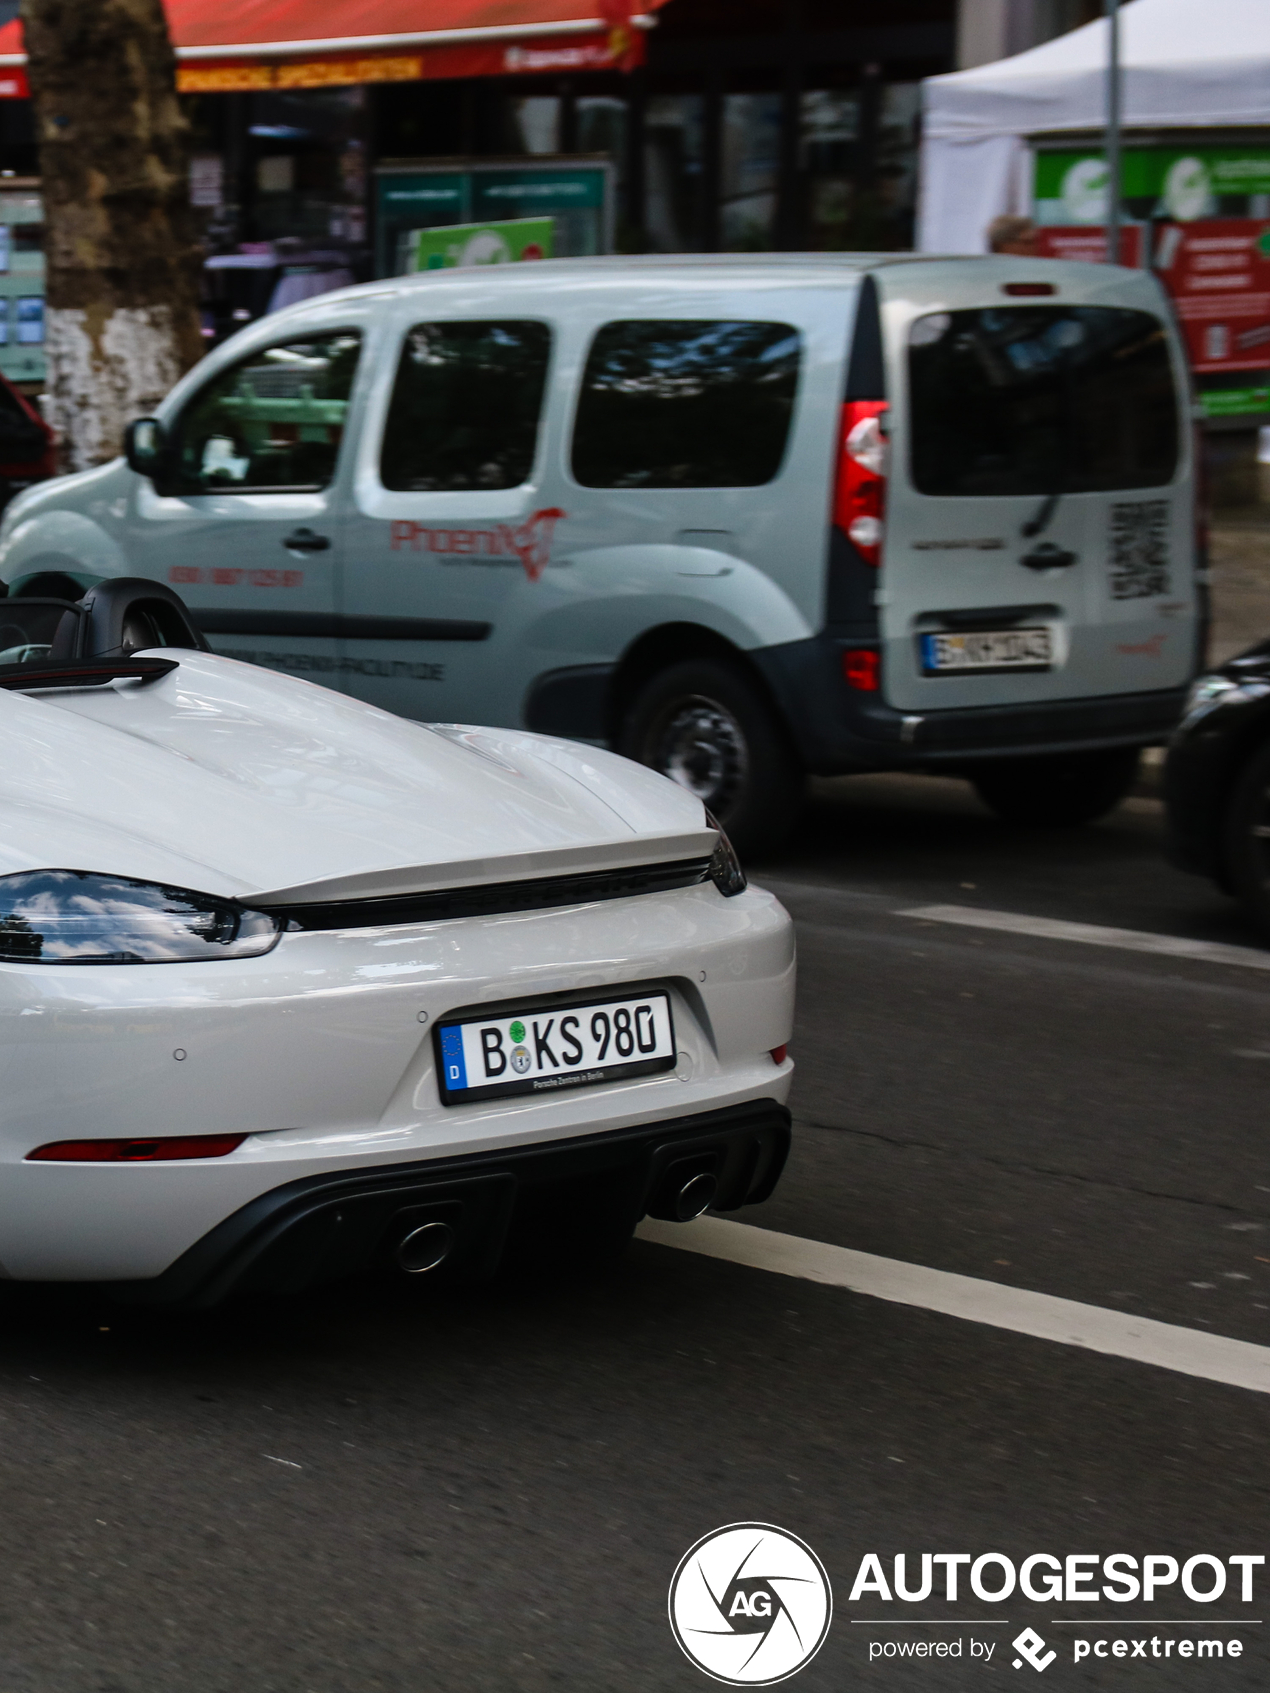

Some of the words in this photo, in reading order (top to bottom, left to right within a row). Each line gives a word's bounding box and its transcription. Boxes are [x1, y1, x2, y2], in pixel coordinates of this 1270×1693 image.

[480, 1026, 508, 1078] B
[532, 1015, 584, 1070] KS
[590, 1004, 657, 1061] 980
[449, 1065, 460, 1080] D
[533, 1078, 558, 1089] Porsche
[587, 1070, 605, 1080] Berlin
